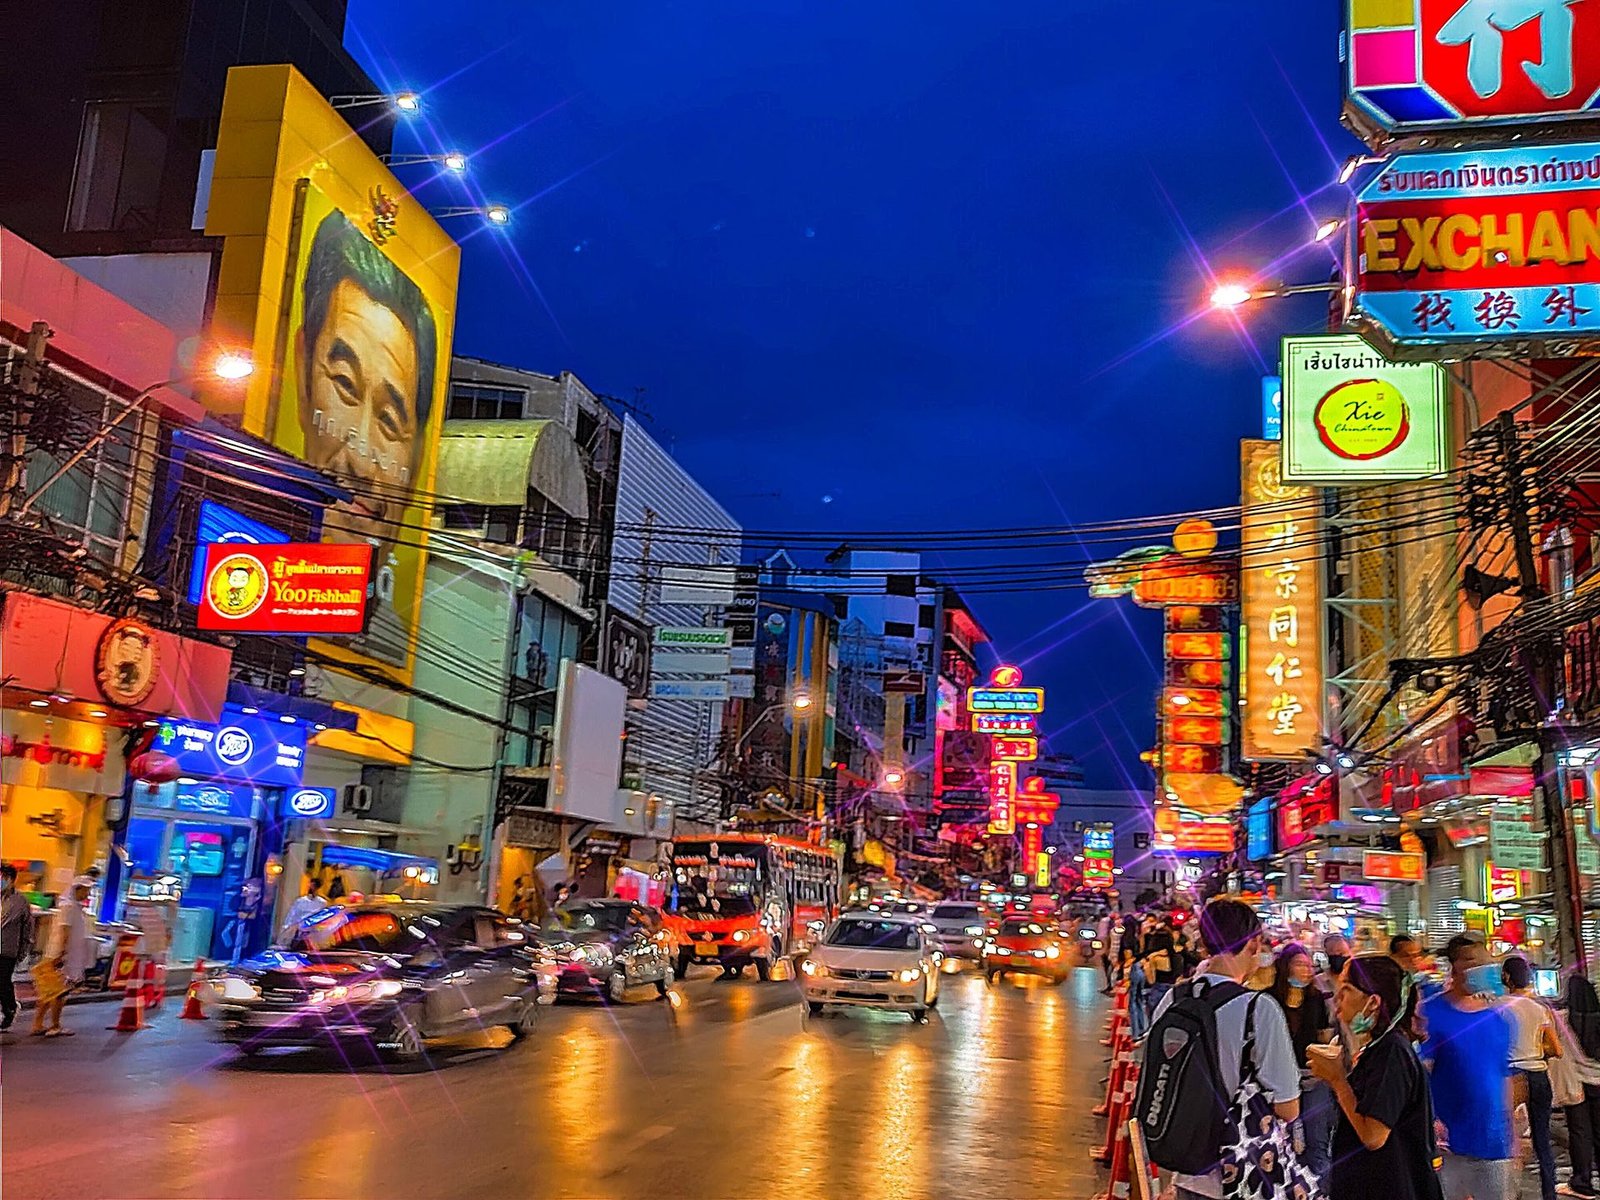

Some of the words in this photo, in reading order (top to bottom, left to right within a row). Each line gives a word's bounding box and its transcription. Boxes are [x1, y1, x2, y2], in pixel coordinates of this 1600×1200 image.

[307, 588, 362, 604] Fishball
[1264, 512, 1303, 735] 北京同仁堂
[1147, 1064, 1171, 1126] DUCATI
